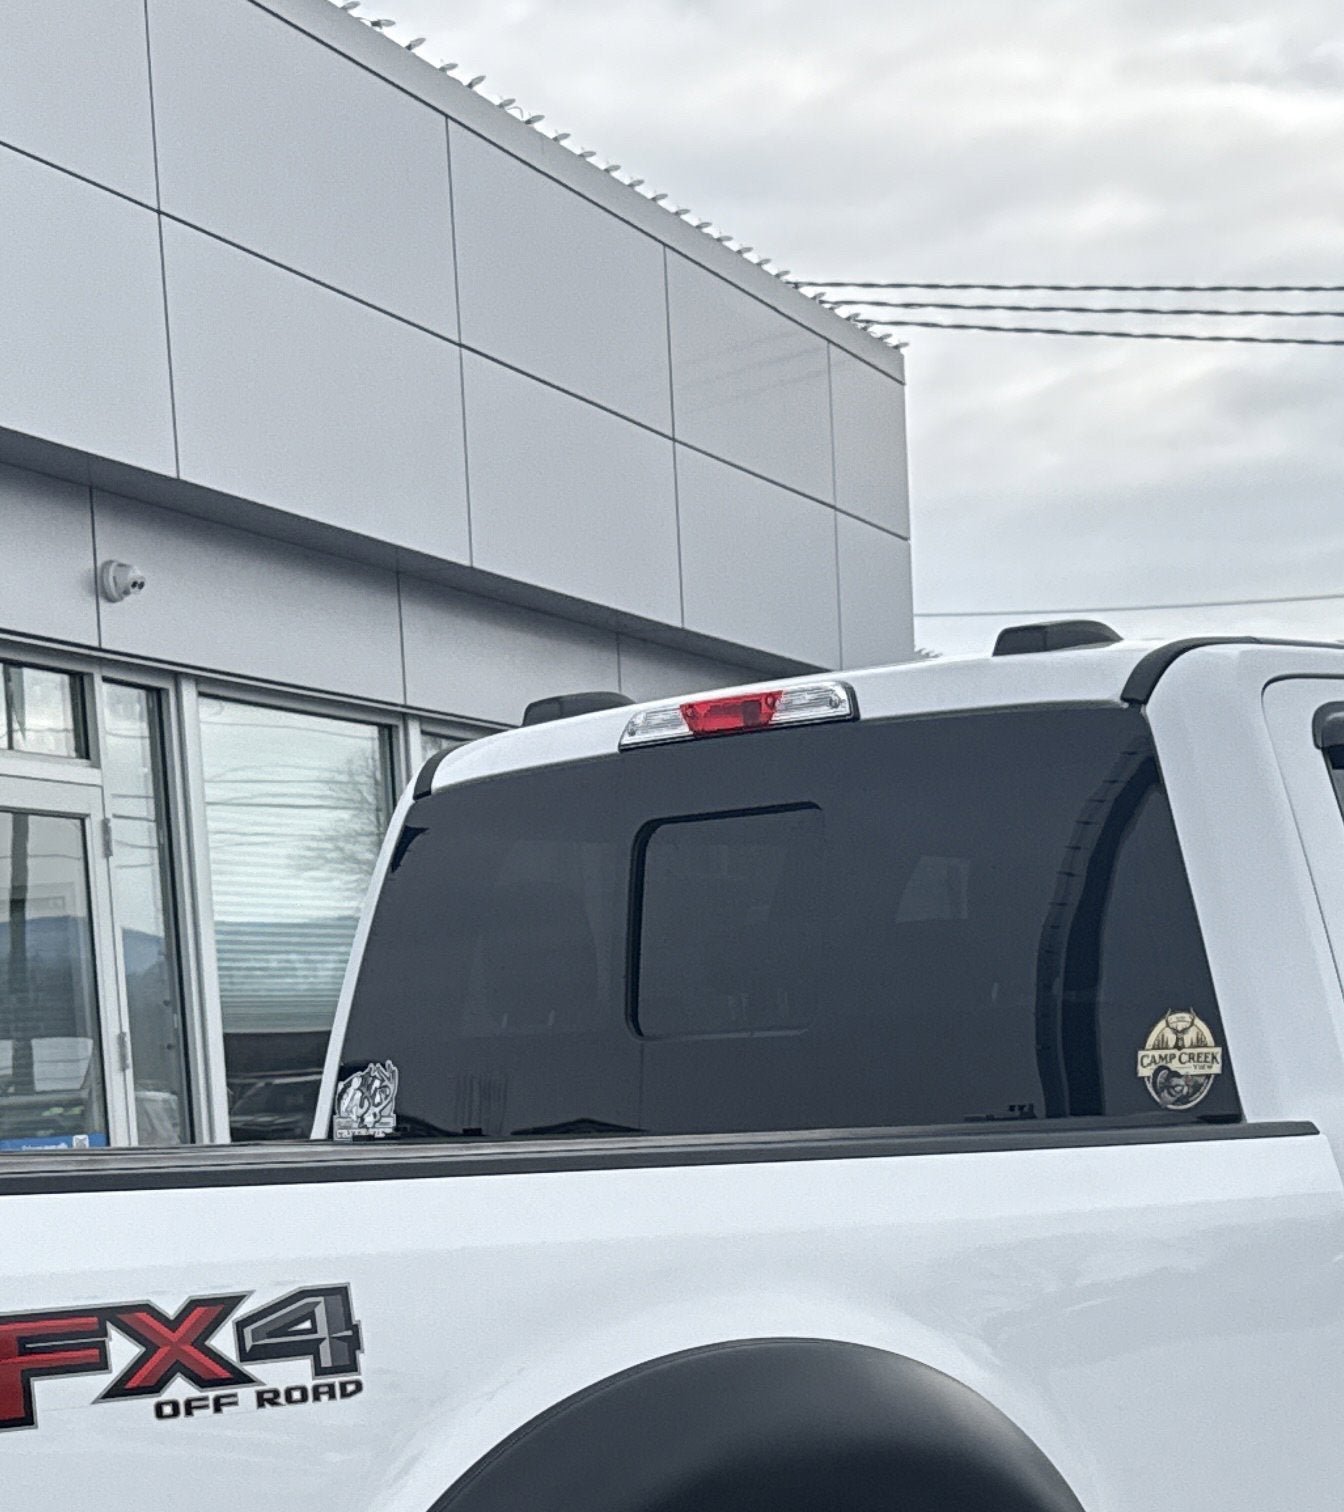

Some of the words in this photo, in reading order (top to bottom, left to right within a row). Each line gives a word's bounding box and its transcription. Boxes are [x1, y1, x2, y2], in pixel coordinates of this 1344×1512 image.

[1140, 1053, 1176, 1068] CAMP
[1178, 1051, 1220, 1065] CREEK
[154, 1392, 240, 1421] OFF
[253, 1376, 364, 1410] ROAD
